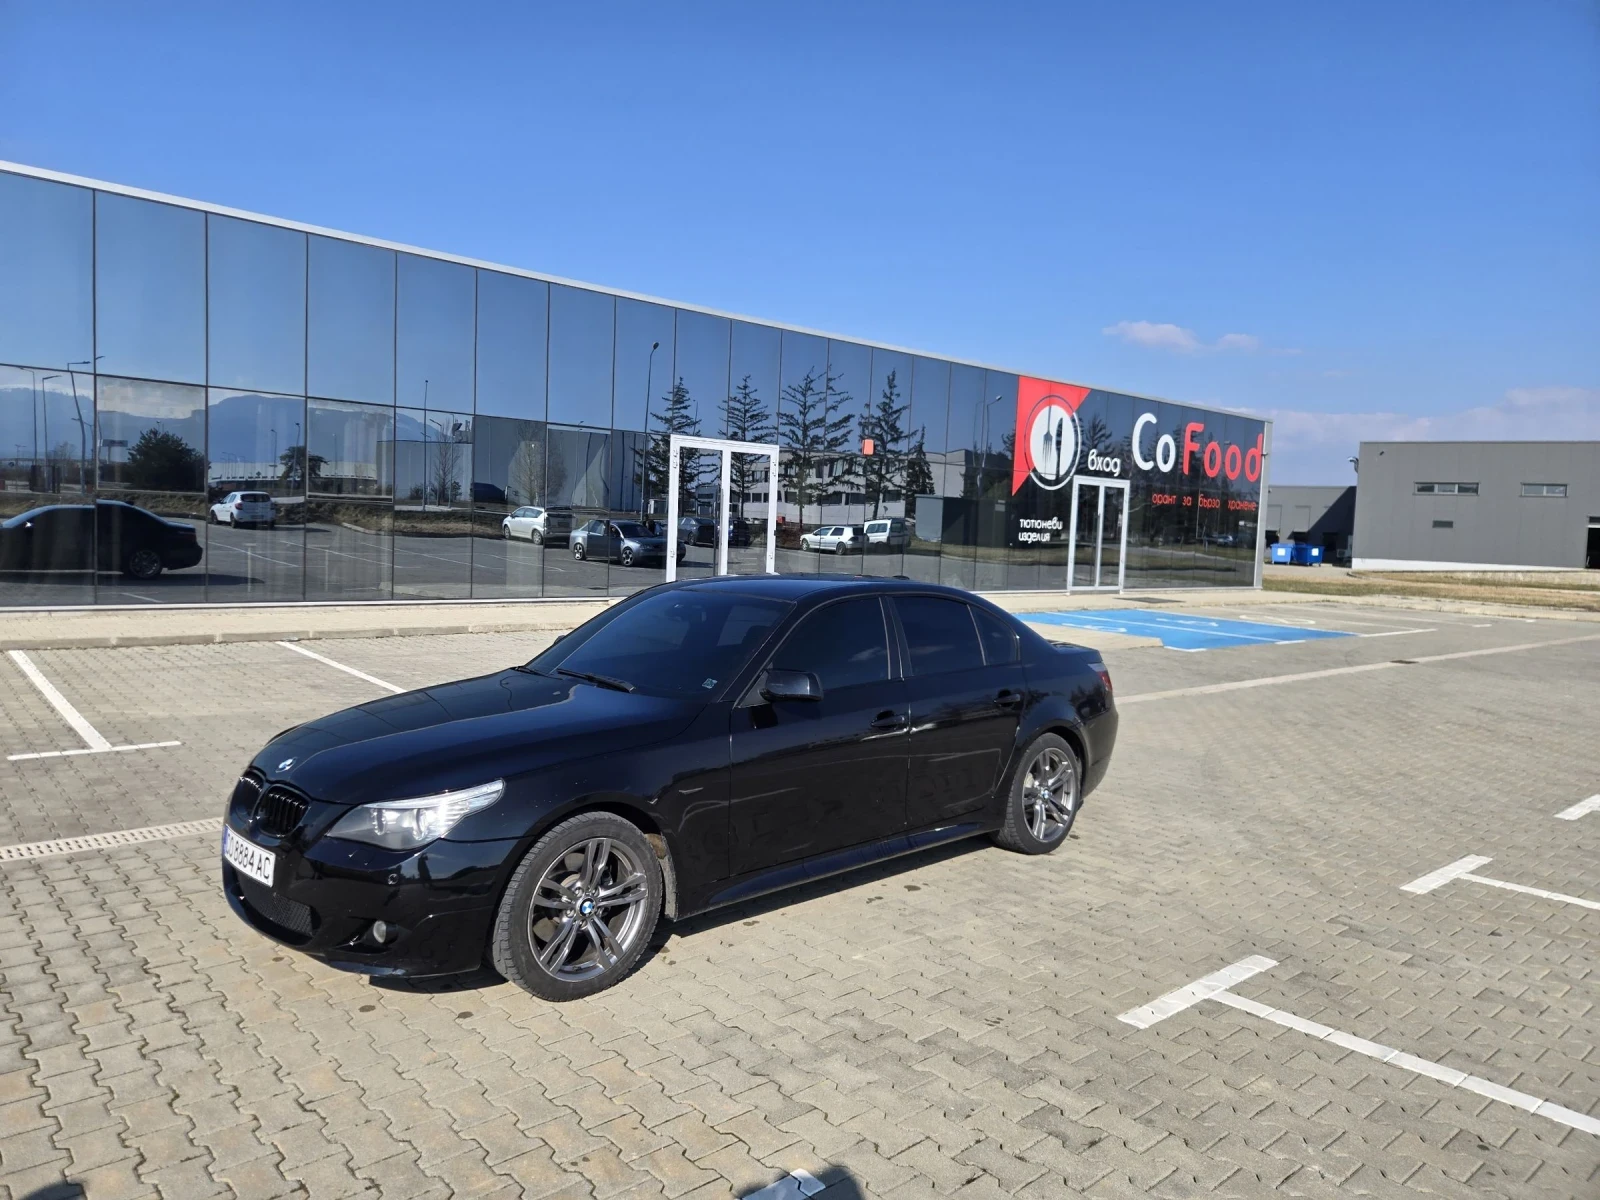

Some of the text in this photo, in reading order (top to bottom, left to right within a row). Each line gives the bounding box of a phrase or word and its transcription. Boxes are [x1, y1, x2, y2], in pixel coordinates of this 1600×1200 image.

[1132, 412, 1263, 482] CoFood
[1087, 448, 1121, 477] вход
[1182, 496, 1192, 506] за
[1198, 494, 1221, 509] бързо
[1227, 499, 1257, 511] хранене
[1019, 516, 1063, 530] тютюневи
[1018, 532, 1051, 544] изделия
